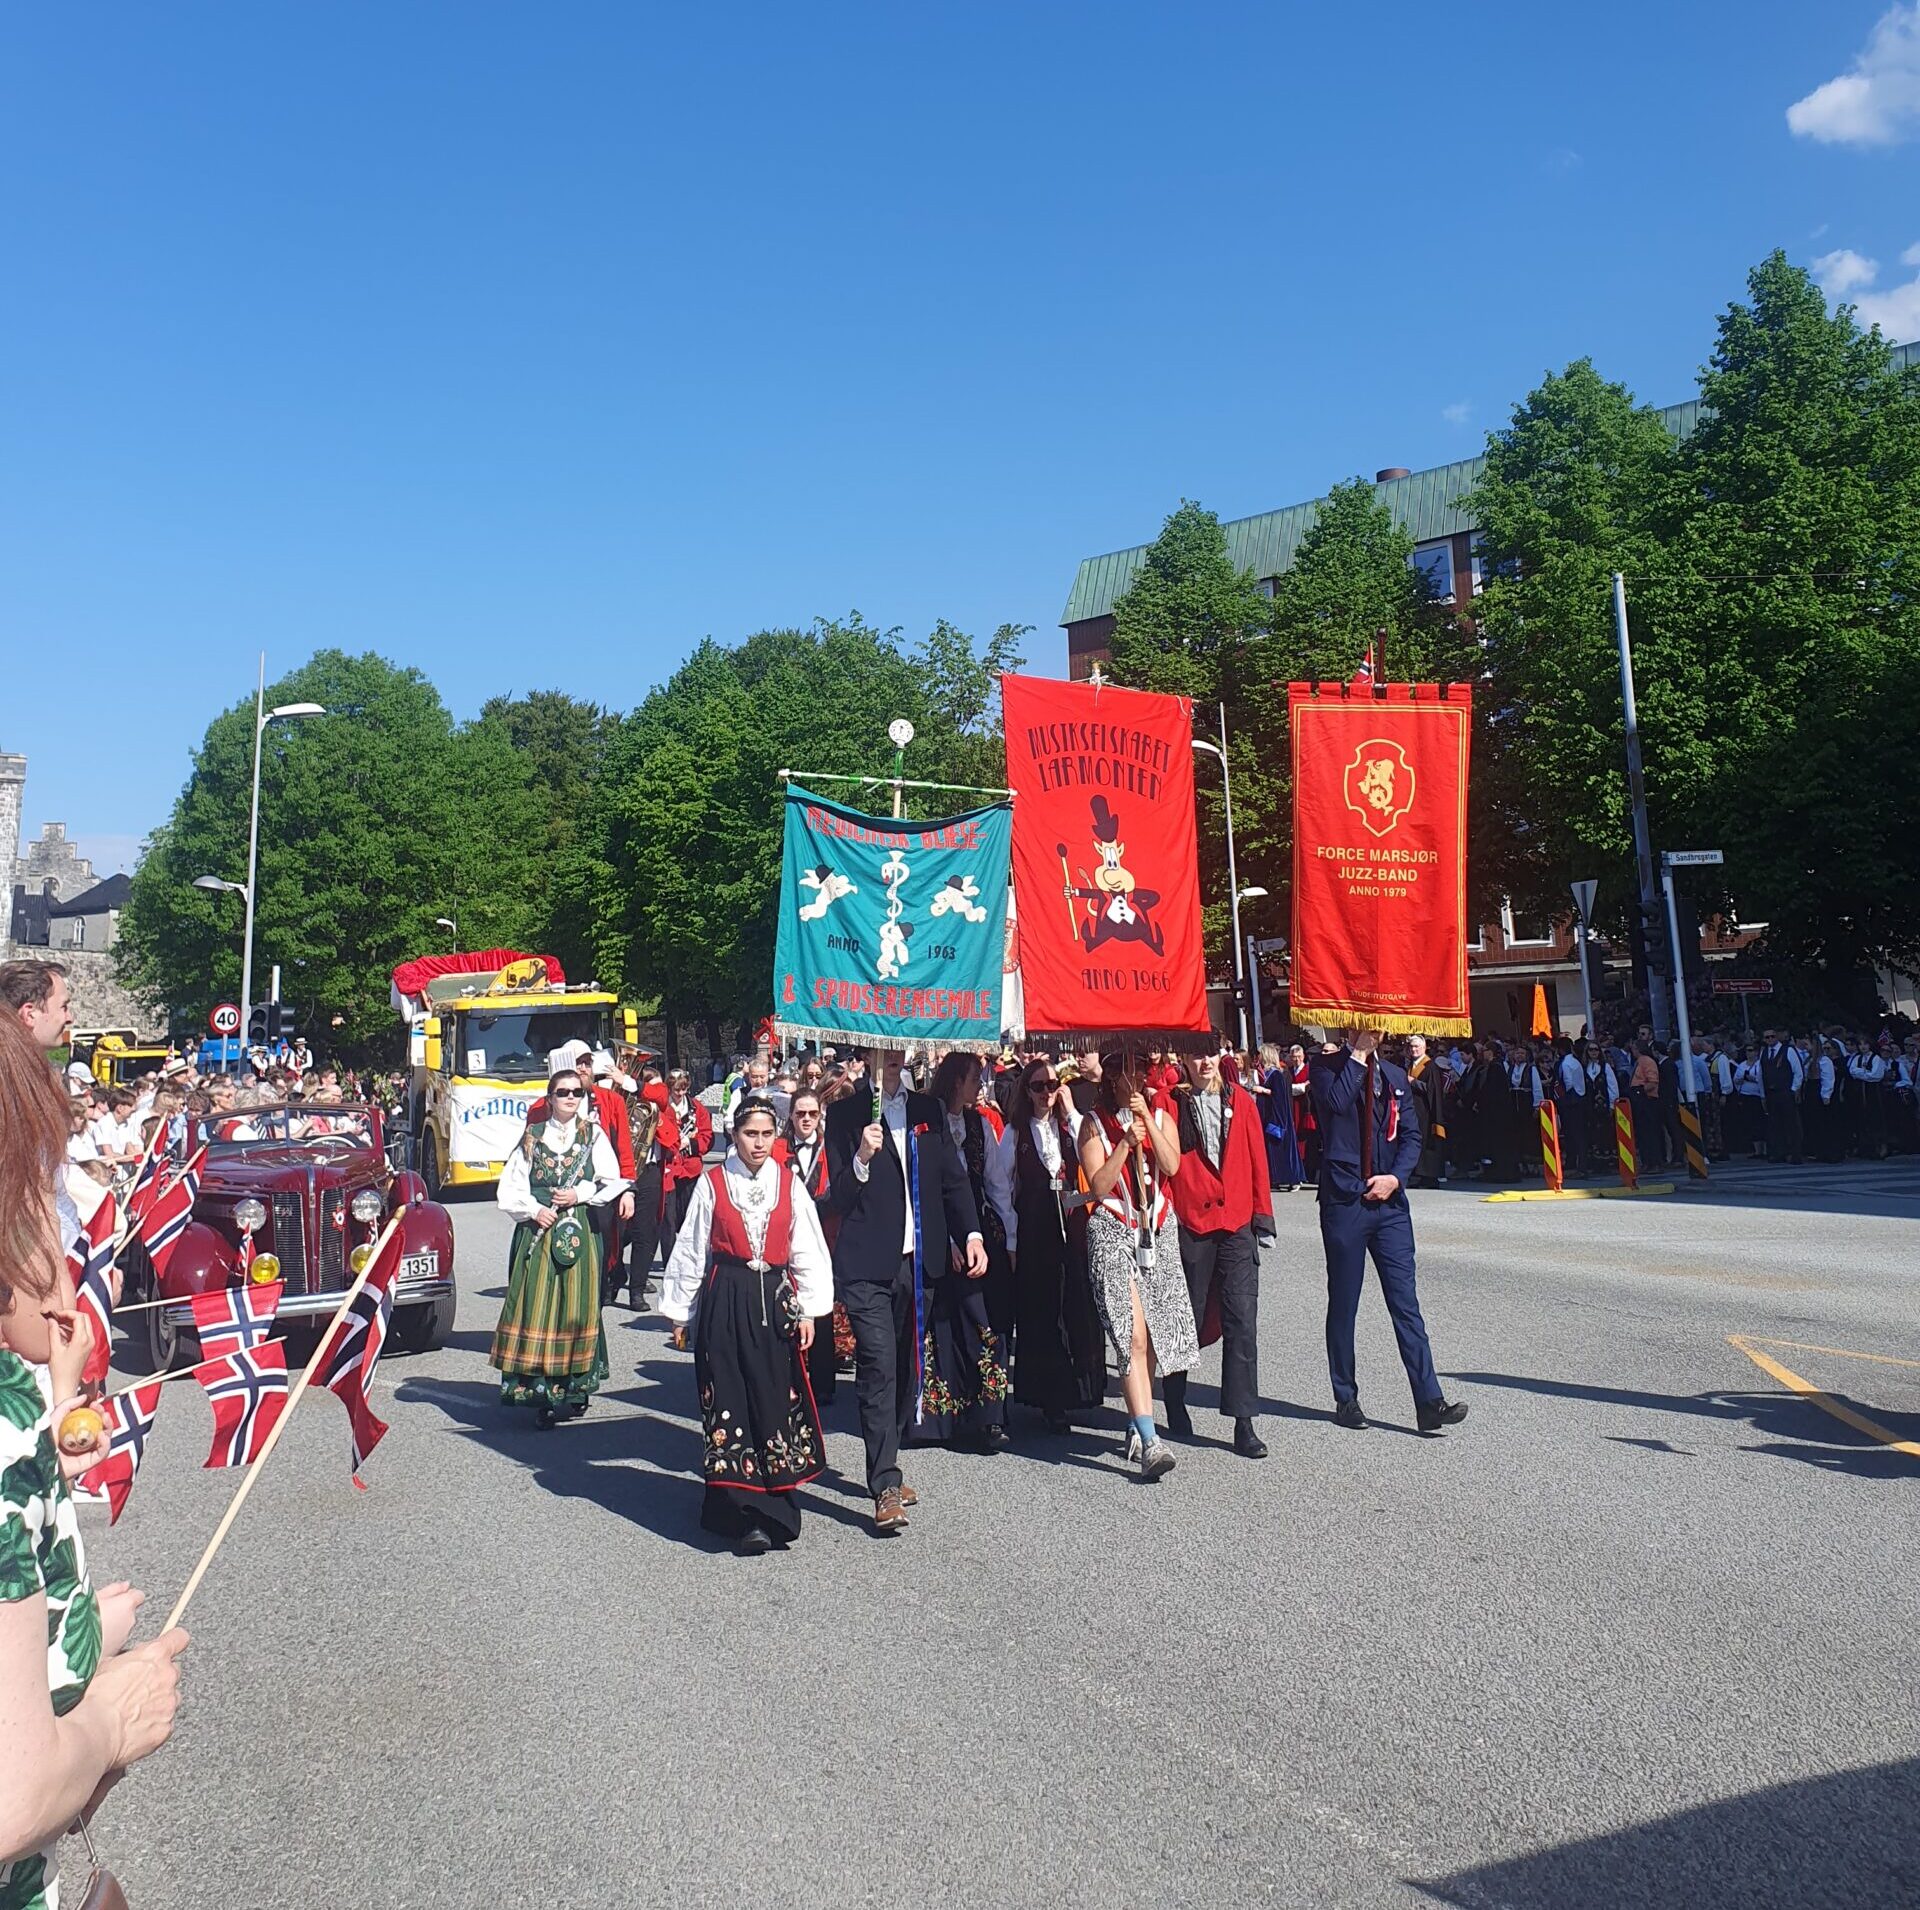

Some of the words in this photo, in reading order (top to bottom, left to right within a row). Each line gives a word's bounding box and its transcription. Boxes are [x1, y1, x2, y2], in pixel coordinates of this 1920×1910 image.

[1317, 846, 1365, 861] FORCE
[1369, 849, 1438, 864] MARSJØR
[1338, 866, 1418, 882] JUZZ-BAND
[1349, 885, 1380, 897] ANNO
[1383, 887, 1407, 897] 1979
[827, 934, 860, 954] ANNO
[927, 945, 956, 960] 1963
[1081, 968, 1127, 991] ANNO
[1131, 969, 1171, 992] 1966
[216, 1011, 237, 1026] 40
[472, 1053, 482, 1069] 3
